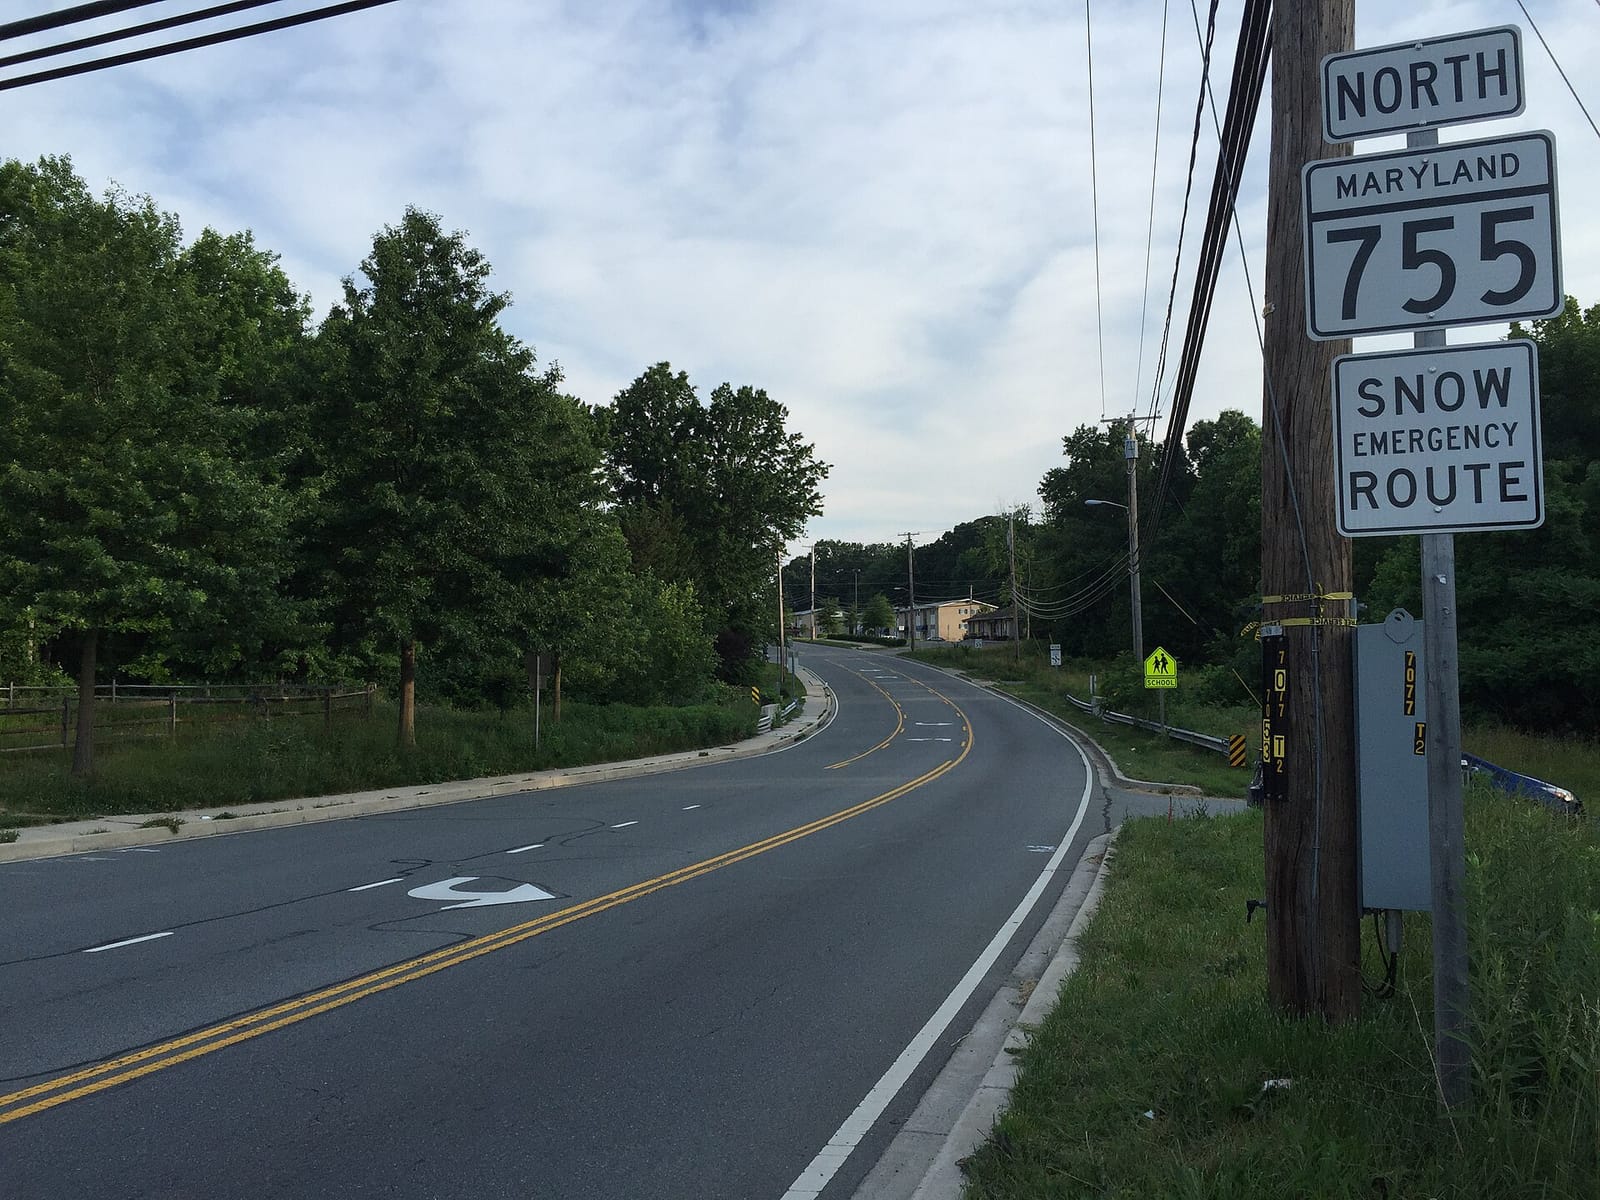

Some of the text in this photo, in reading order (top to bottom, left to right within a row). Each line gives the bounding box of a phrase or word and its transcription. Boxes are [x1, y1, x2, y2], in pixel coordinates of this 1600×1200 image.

[1336, 48, 1508, 121] NORTH
[1336, 152, 1520, 200] MARYLAND
[1326, 205, 1537, 320] 755
[1357, 366, 1512, 418] SNOW
[1353, 422, 1518, 457] EMERGENCY
[1349, 461, 1528, 511] ROUTE
[1146, 679, 1175, 687] SCHOOL
[1406, 652, 1415, 715] 7077
[1274, 735, 1285, 773] T2
[1415, 723, 1425, 754] T2
